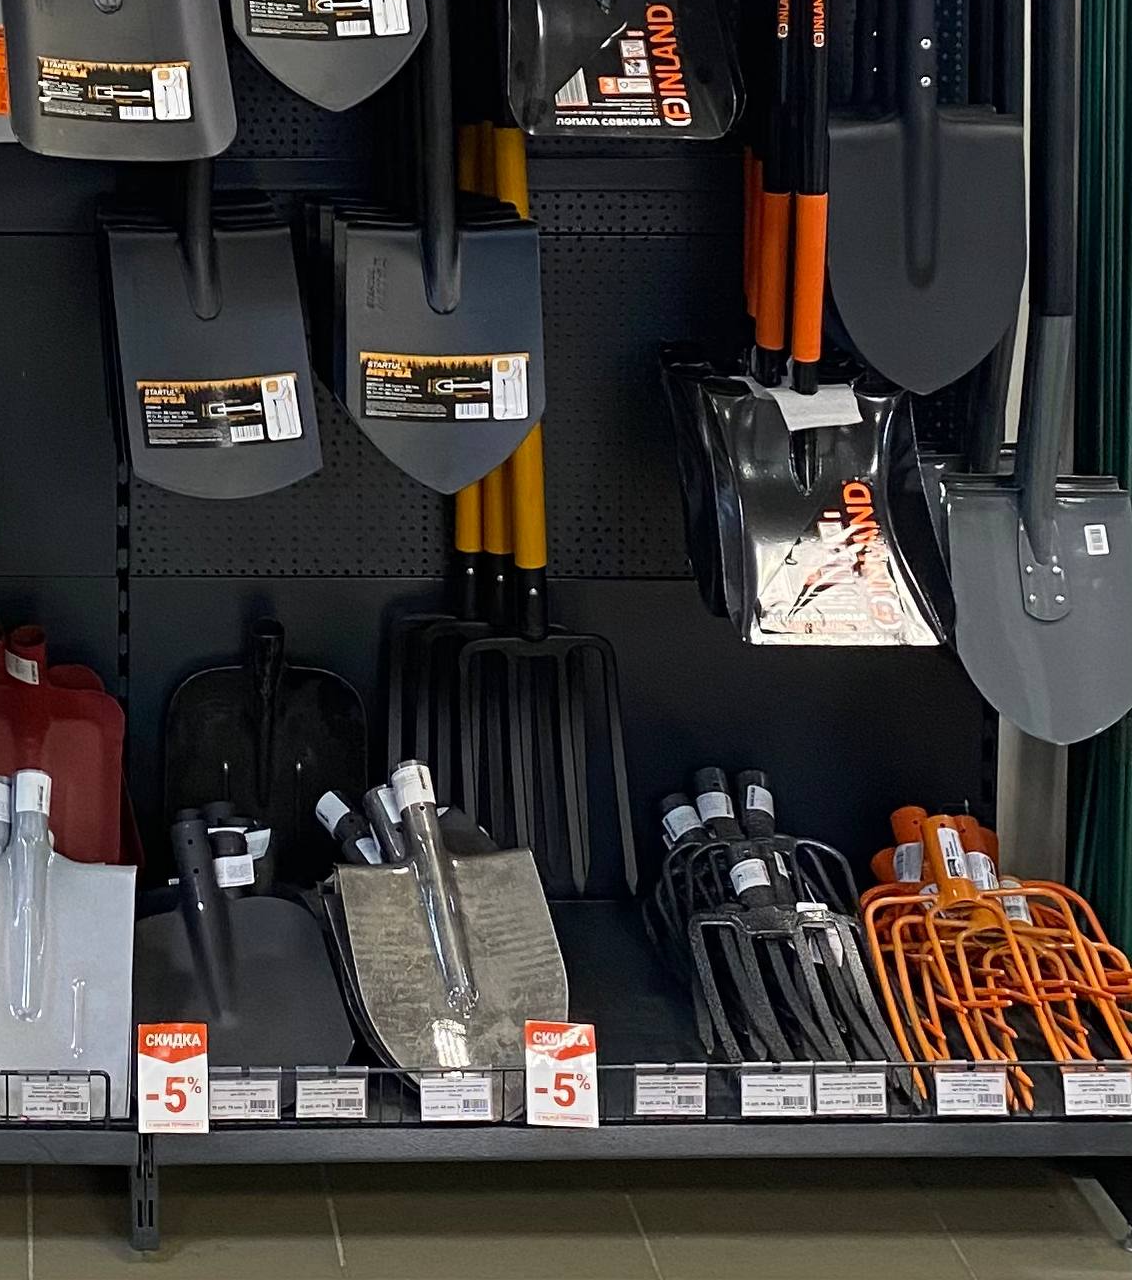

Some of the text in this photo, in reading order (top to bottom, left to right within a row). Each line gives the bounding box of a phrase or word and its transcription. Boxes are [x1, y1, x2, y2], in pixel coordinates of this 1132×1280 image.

[646, 4, 692, 126] FINLAND
[555, 117, 661, 126] ЛОПАТА СОВКОВАЯ
[368, 361, 404, 371] STARTUL
[144, 1032, 202, 1050] СКИДКА
[145, 1075, 203, 1113] -5%
[535, 1071, 591, 1109] -5%
